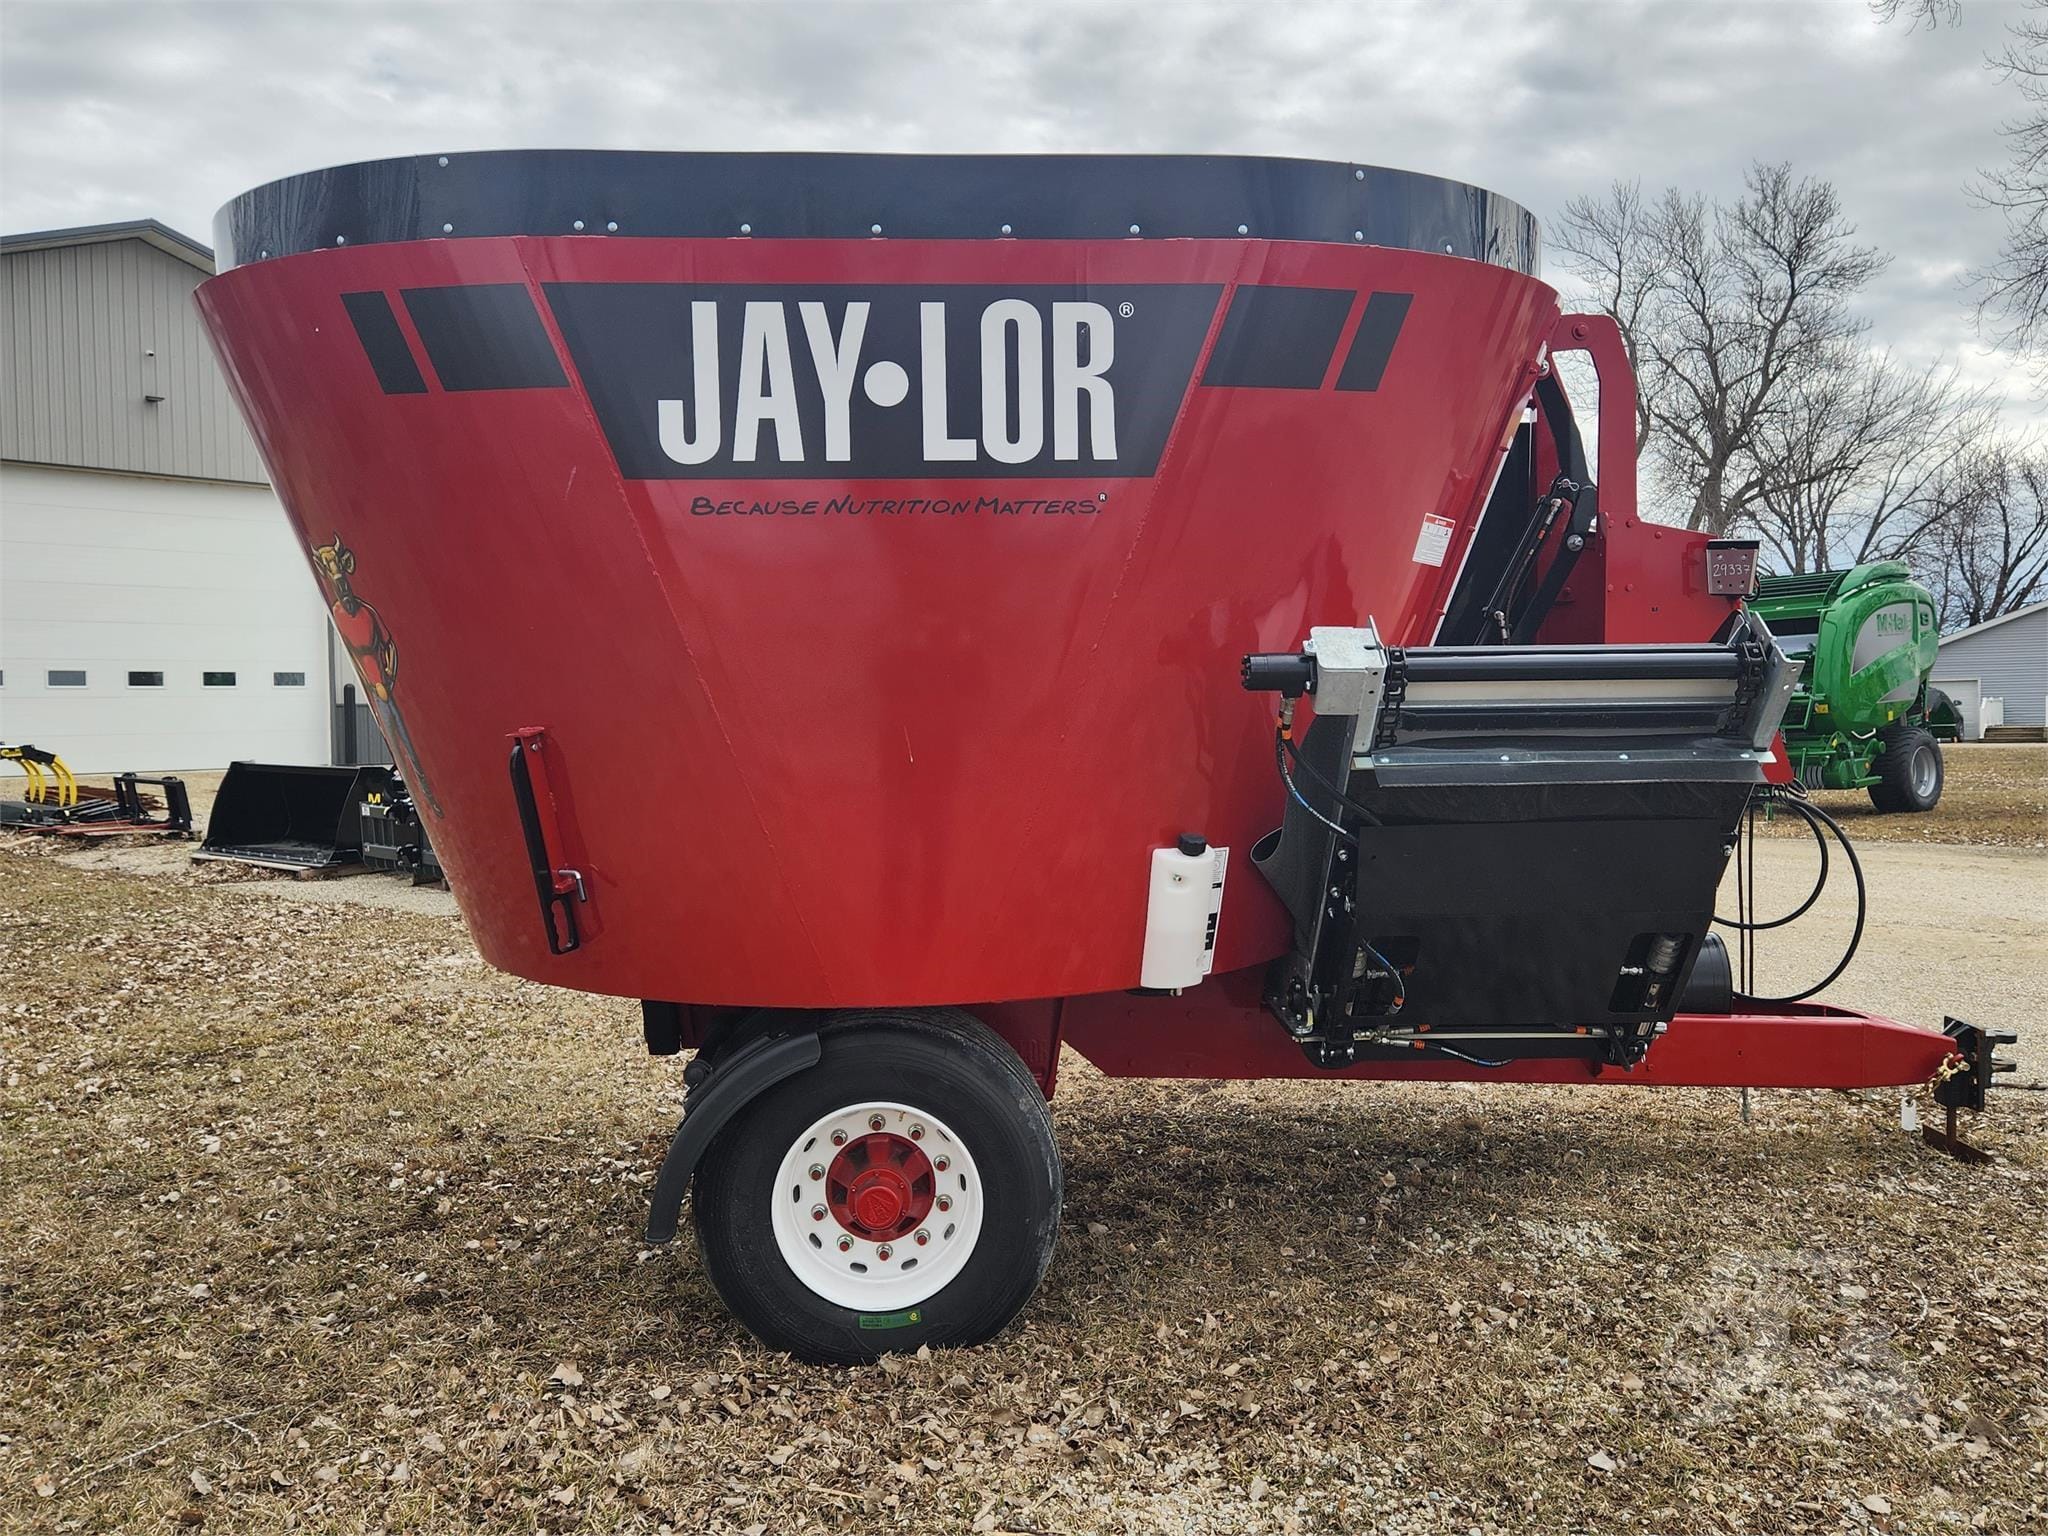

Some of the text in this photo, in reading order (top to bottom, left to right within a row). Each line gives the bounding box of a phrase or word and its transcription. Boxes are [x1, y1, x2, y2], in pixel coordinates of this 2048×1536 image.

[690, 496, 819, 516] BECAUSE
[823, 494, 974, 516] NUTRITION
[1712, 563, 1751, 577] 29337
